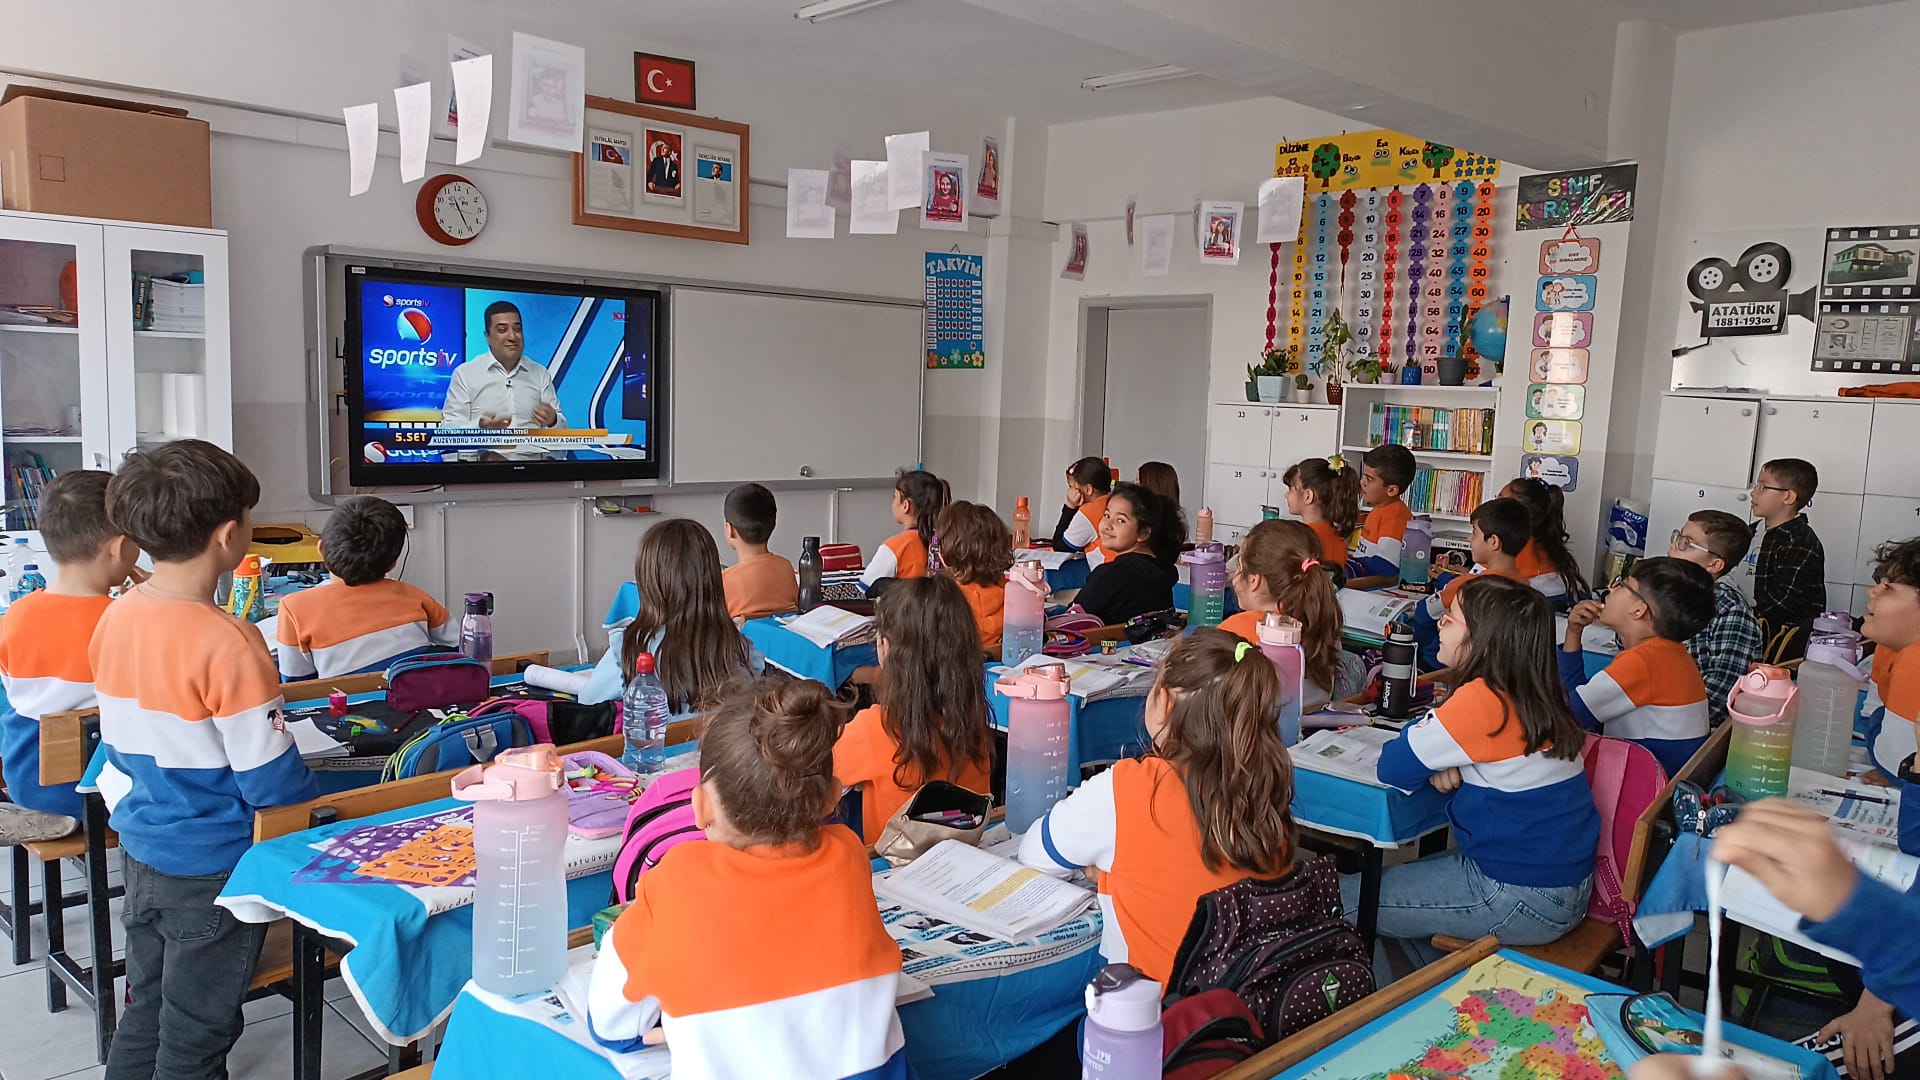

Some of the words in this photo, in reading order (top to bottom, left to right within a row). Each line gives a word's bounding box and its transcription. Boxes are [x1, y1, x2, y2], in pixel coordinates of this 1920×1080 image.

[1548, 174, 1602, 197] SINIF
[1481, 187, 1490, 196] 10
[1435, 210, 1445, 218] 16
[1457, 207, 1467, 215] 18
[1477, 208, 1490, 216] 20
[1366, 215, 1375, 223] 10
[1433, 230, 1445, 238] 24
[1455, 227, 1467, 235] 27
[1475, 228, 1488, 236] 30
[1362, 253, 1374, 261] 20
[927, 256, 981, 277] TAKVİM
[1361, 272, 1372, 280] 25
[1428, 308, 1440, 316] 56
[1712, 303, 1775, 316] ATATÜRK
[1425, 346, 1437, 354] 72
[369, 348, 457, 369] sportstv
[1704, 406, 1709, 414] 1
[1812, 410, 1819, 419] 2
[395, 432, 427, 442] 5.SET
[1699, 490, 1704, 498] 9
[1807, 499, 1812, 508] 0
